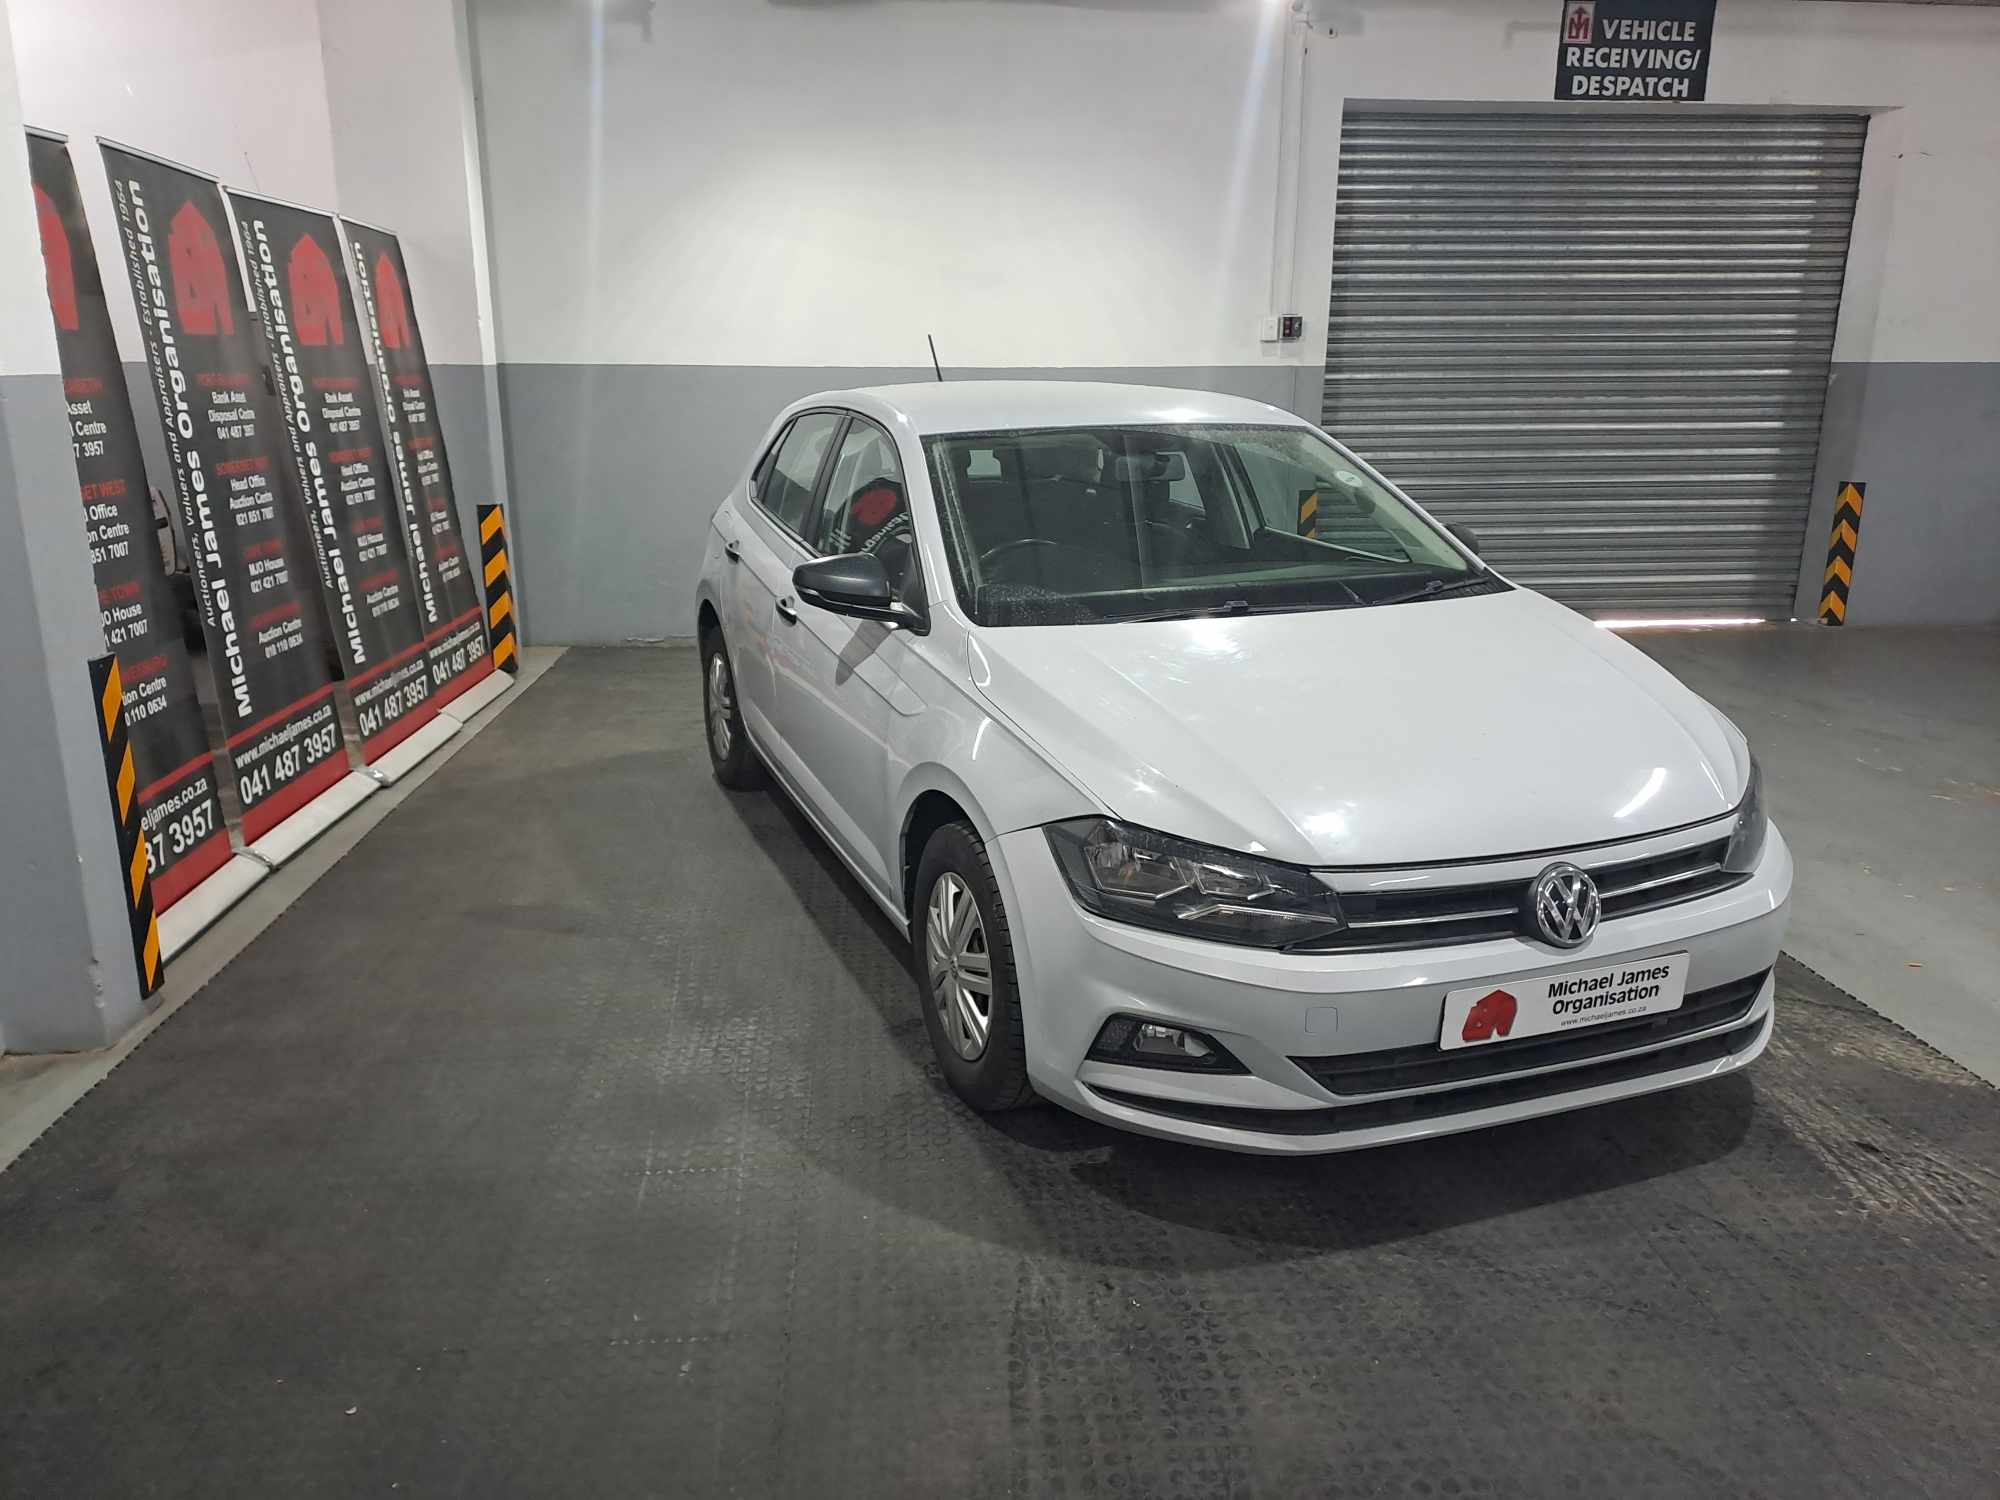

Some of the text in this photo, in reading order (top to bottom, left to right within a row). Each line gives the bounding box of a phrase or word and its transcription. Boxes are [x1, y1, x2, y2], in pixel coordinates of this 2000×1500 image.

[1602, 19, 1697, 42] VEHICLE
[1566, 47, 1702, 71] RECEIVING/
[1571, 75, 1689, 97] DESPATCH
[115, 179, 130, 222] 1964
[124, 226, 152, 325] Established
[253, 220, 310, 432] Organisation
[150, 340, 174, 428] Appraisers
[272, 352, 294, 424] Appraisers
[75, 421, 107, 436] Centre
[168, 431, 182, 463] and
[287, 426, 301, 453] and
[82, 440, 104, 457] 3957
[128, 179, 253, 718] Michael James Organisation
[177, 467, 195, 526] Valuers
[305, 441, 337, 540] James
[89, 503, 118, 520] Office
[99, 522, 130, 540] Centre
[108, 541, 129, 559] 7007
[409, 523, 438, 623] Michael
[112, 603, 142, 622] House
[328, 548, 366, 664] Michael
[111, 627, 127, 644] 421
[128, 619, 148, 639] 7007
[432, 635, 485, 685] 041 487 3957
[139, 676, 167, 697] Centre
[360, 675, 428, 736] 041 487 3957
[131, 704, 146, 722] 110
[235, 705, 332, 768] www.michaeljames.co.za
[240, 723, 336, 804] 041 487 3957
[141, 778, 208, 831] eljames.co.za
[168, 799, 213, 853] 3957
[1548, 965, 1669, 998] Michael James
[1552, 984, 1660, 1015] Organisation
